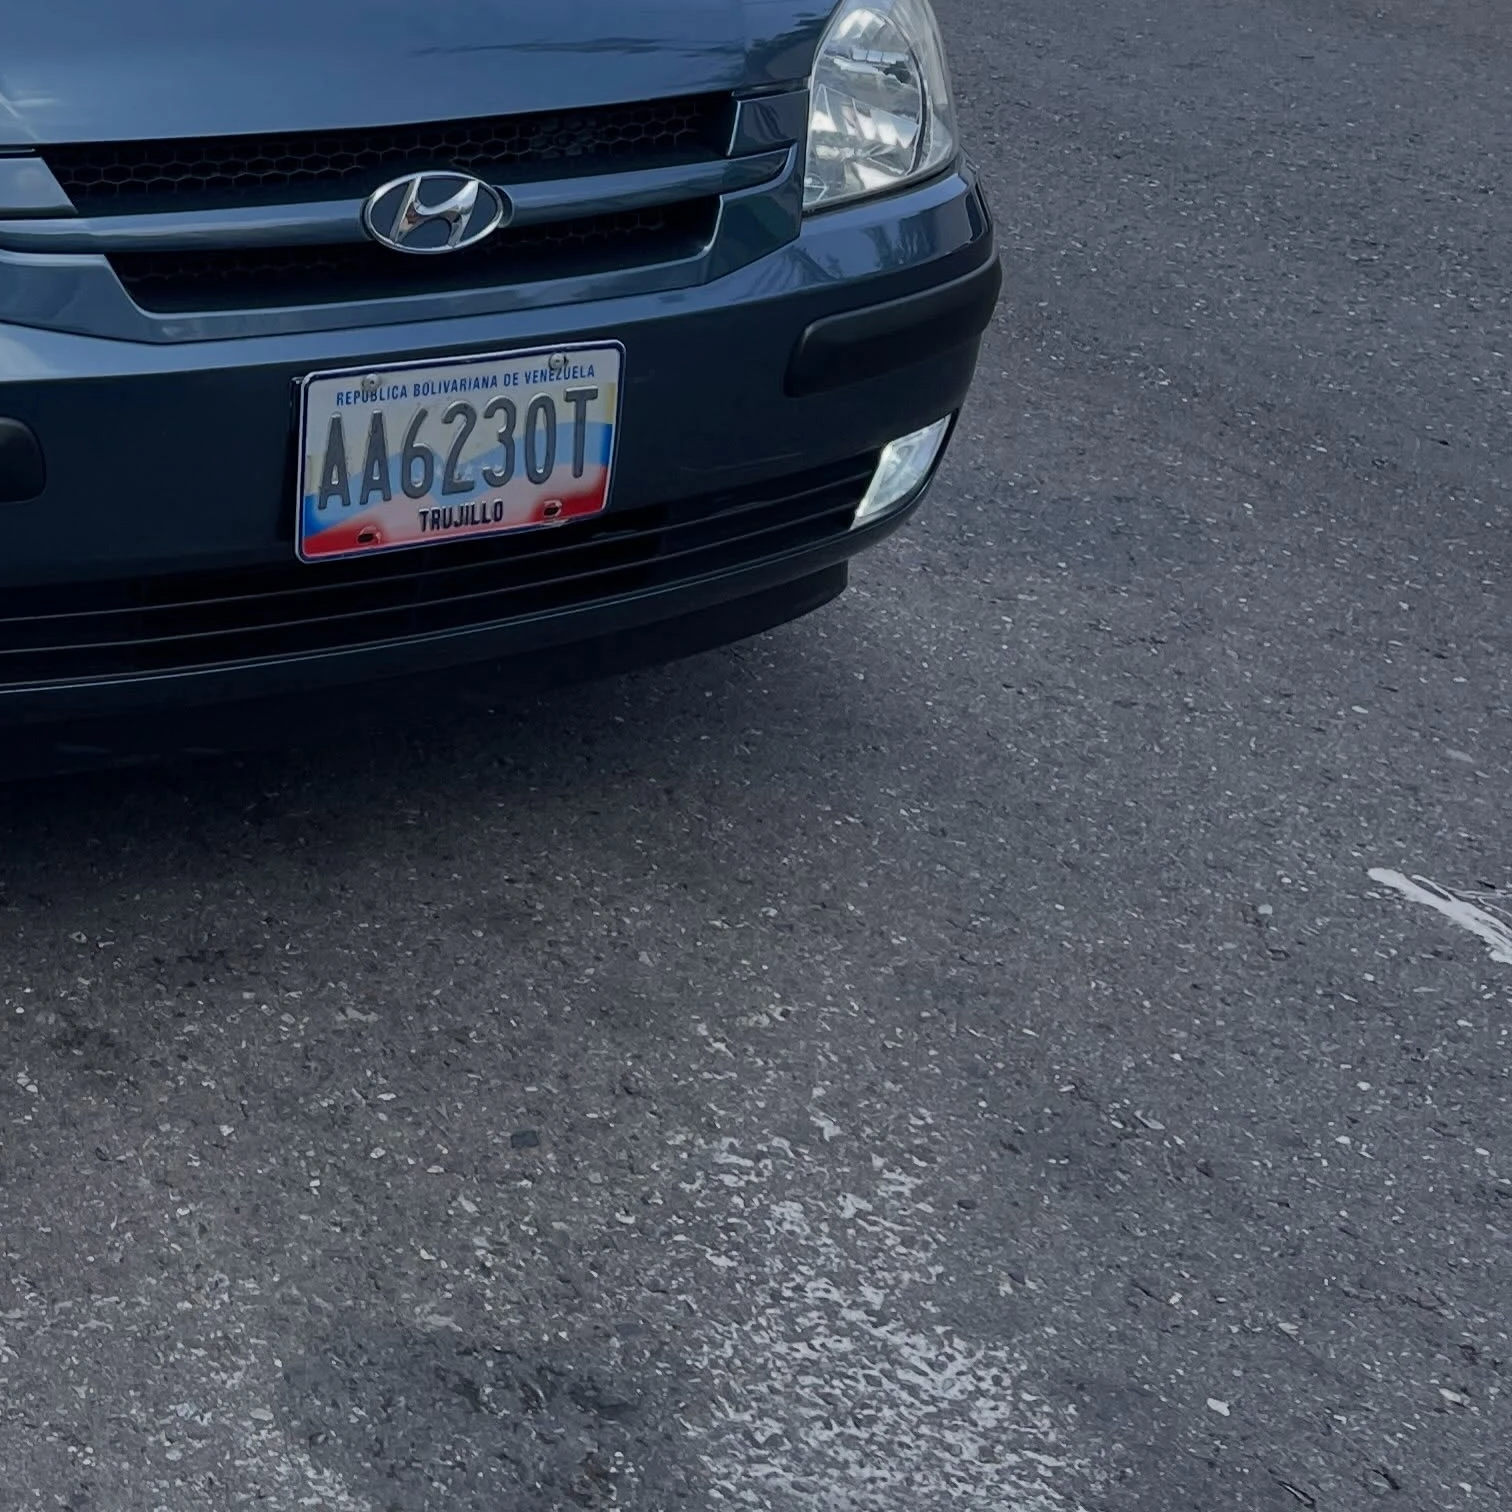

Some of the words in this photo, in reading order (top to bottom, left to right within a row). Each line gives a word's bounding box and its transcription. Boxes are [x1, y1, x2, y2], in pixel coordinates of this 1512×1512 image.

[413, 378, 498, 397] BOLIVARIANA
[503, 372, 518, 387] DE
[524, 364, 595, 384] VENEZUELA
[318, 385, 599, 510] AA6230T
[419, 499, 504, 532] TRUJILLO
